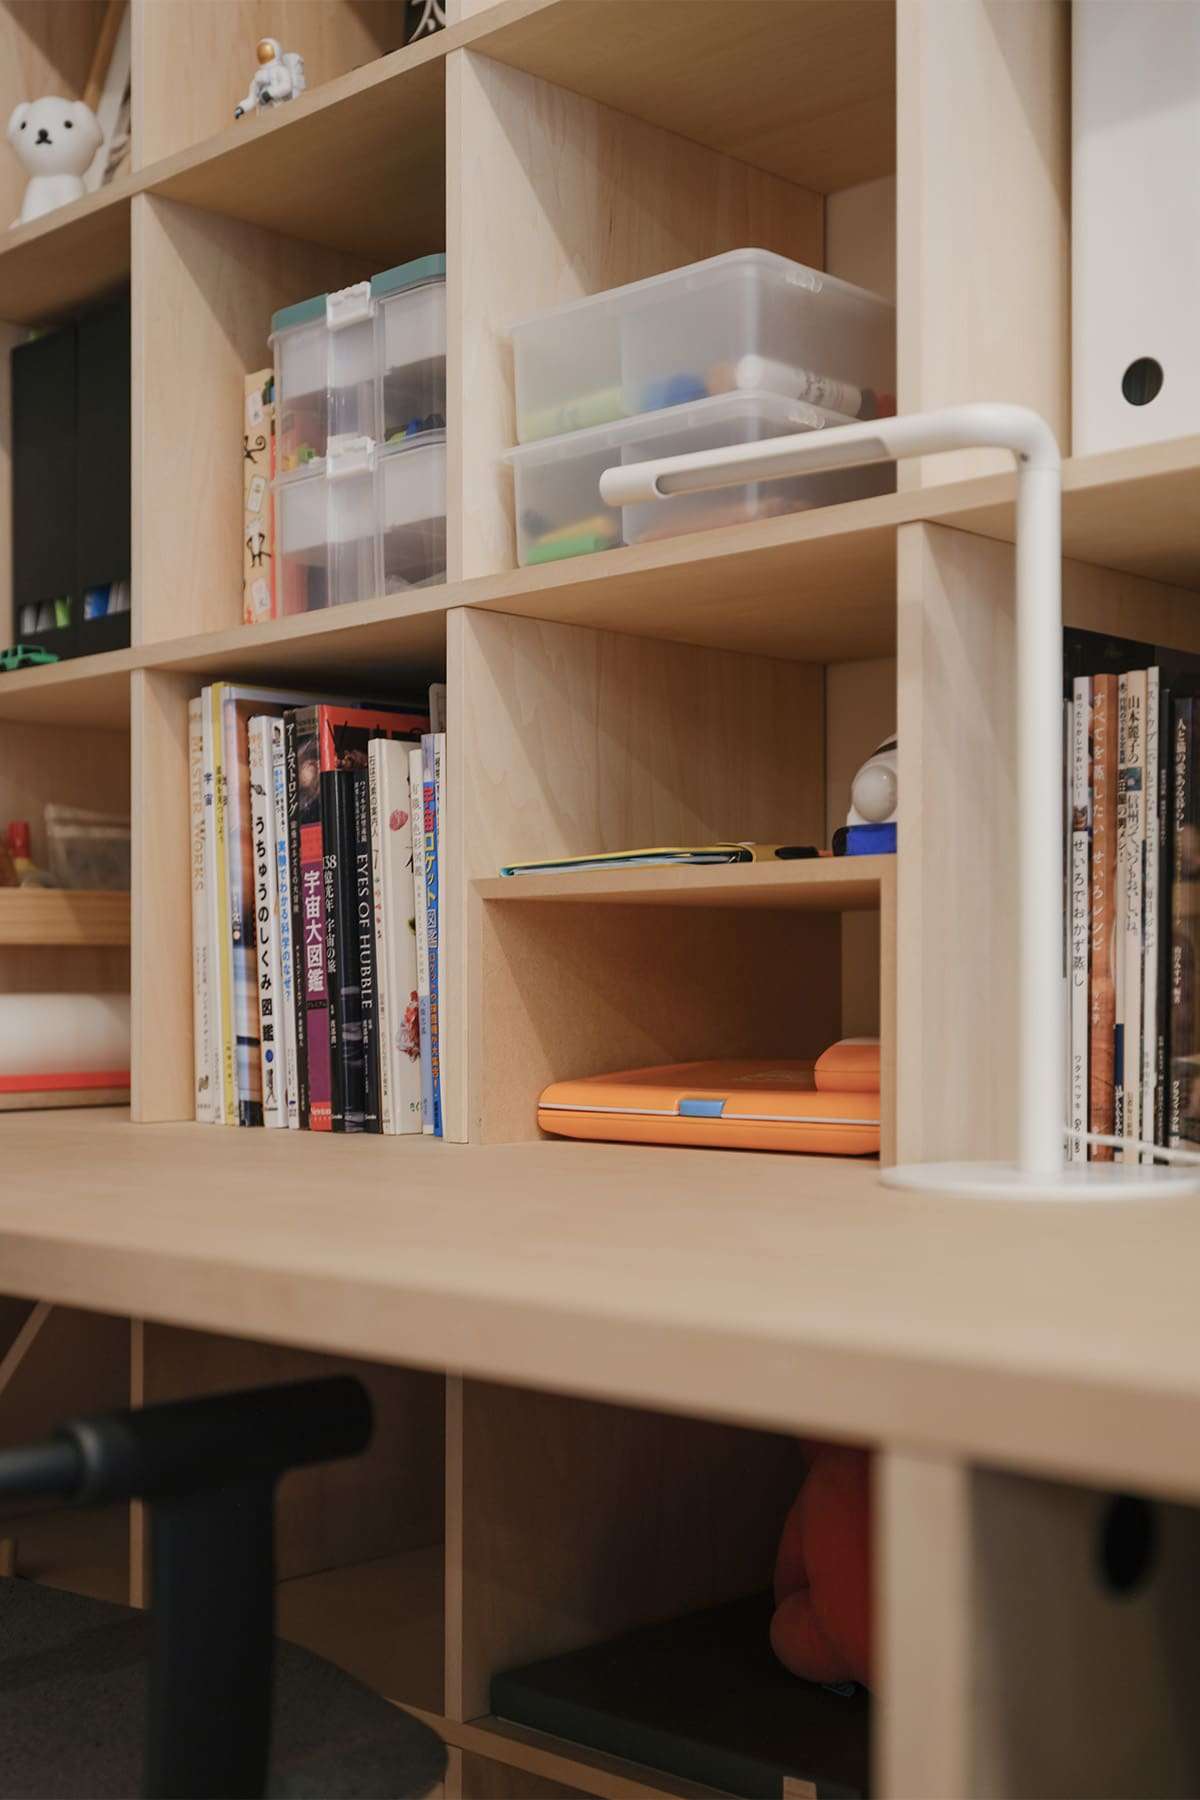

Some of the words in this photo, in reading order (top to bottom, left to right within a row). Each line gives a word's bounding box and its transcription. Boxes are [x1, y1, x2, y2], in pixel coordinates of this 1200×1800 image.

[286, 722, 298, 817] アームストロング
[356, 854, 370, 897] EYES
[358, 902, 371, 928] OF
[1073, 839, 1086, 988] せいろでおかず蒸し
[256, 816, 274, 1042] うちゅうのしくみ図鑑
[303, 869, 325, 992] 宇宙大図鑑
[359, 934, 373, 1009] HUBBLE
